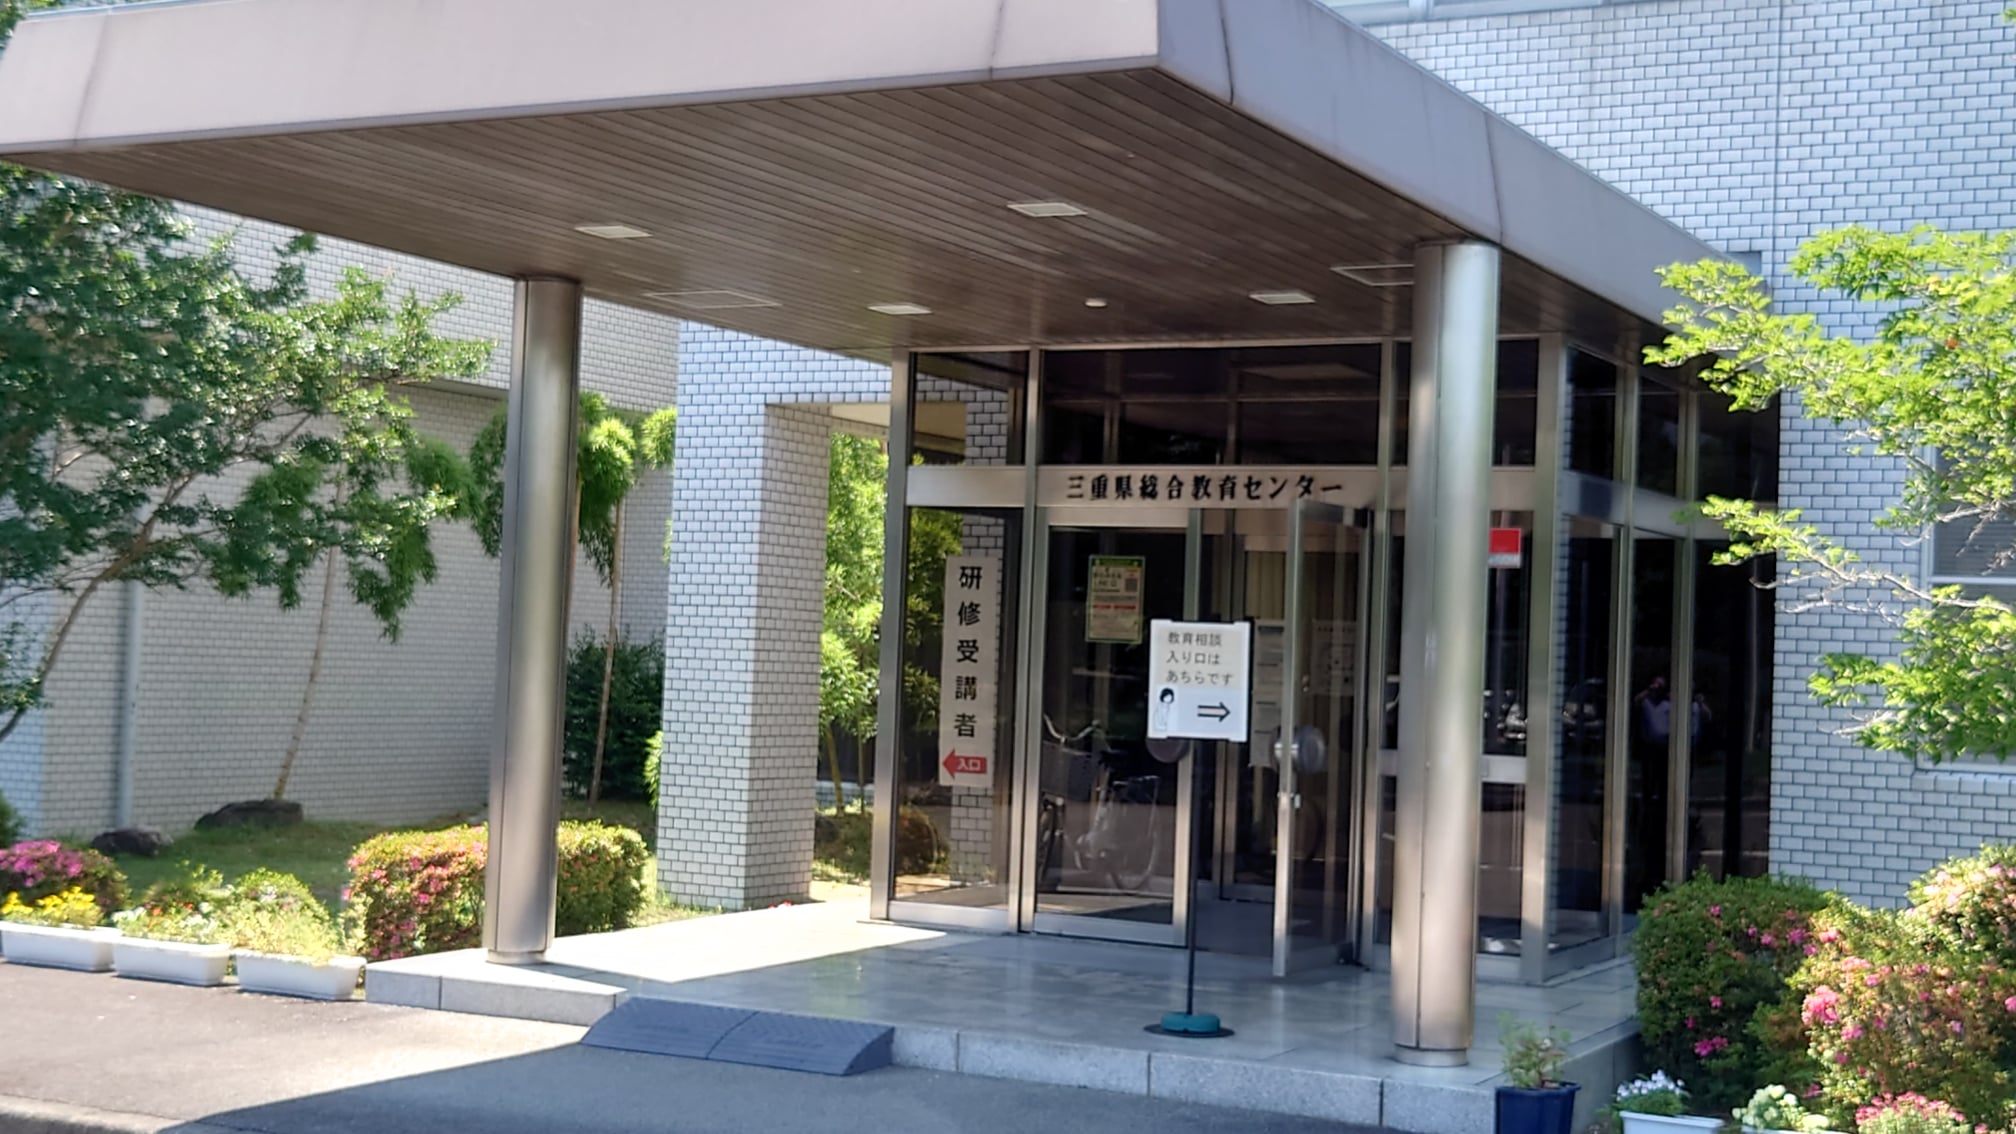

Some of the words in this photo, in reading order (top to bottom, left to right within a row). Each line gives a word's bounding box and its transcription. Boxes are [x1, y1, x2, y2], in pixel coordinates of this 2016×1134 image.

[1066, 474, 1343, 501] 三重県総合教育センター
[1168, 632, 1222, 647] 教育相談
[954, 565, 983, 738] 研修受講者
[1166, 650, 1220, 665] 入り口は
[1166, 670, 1233, 686] あちらです
[957, 758, 981, 771] 入口
